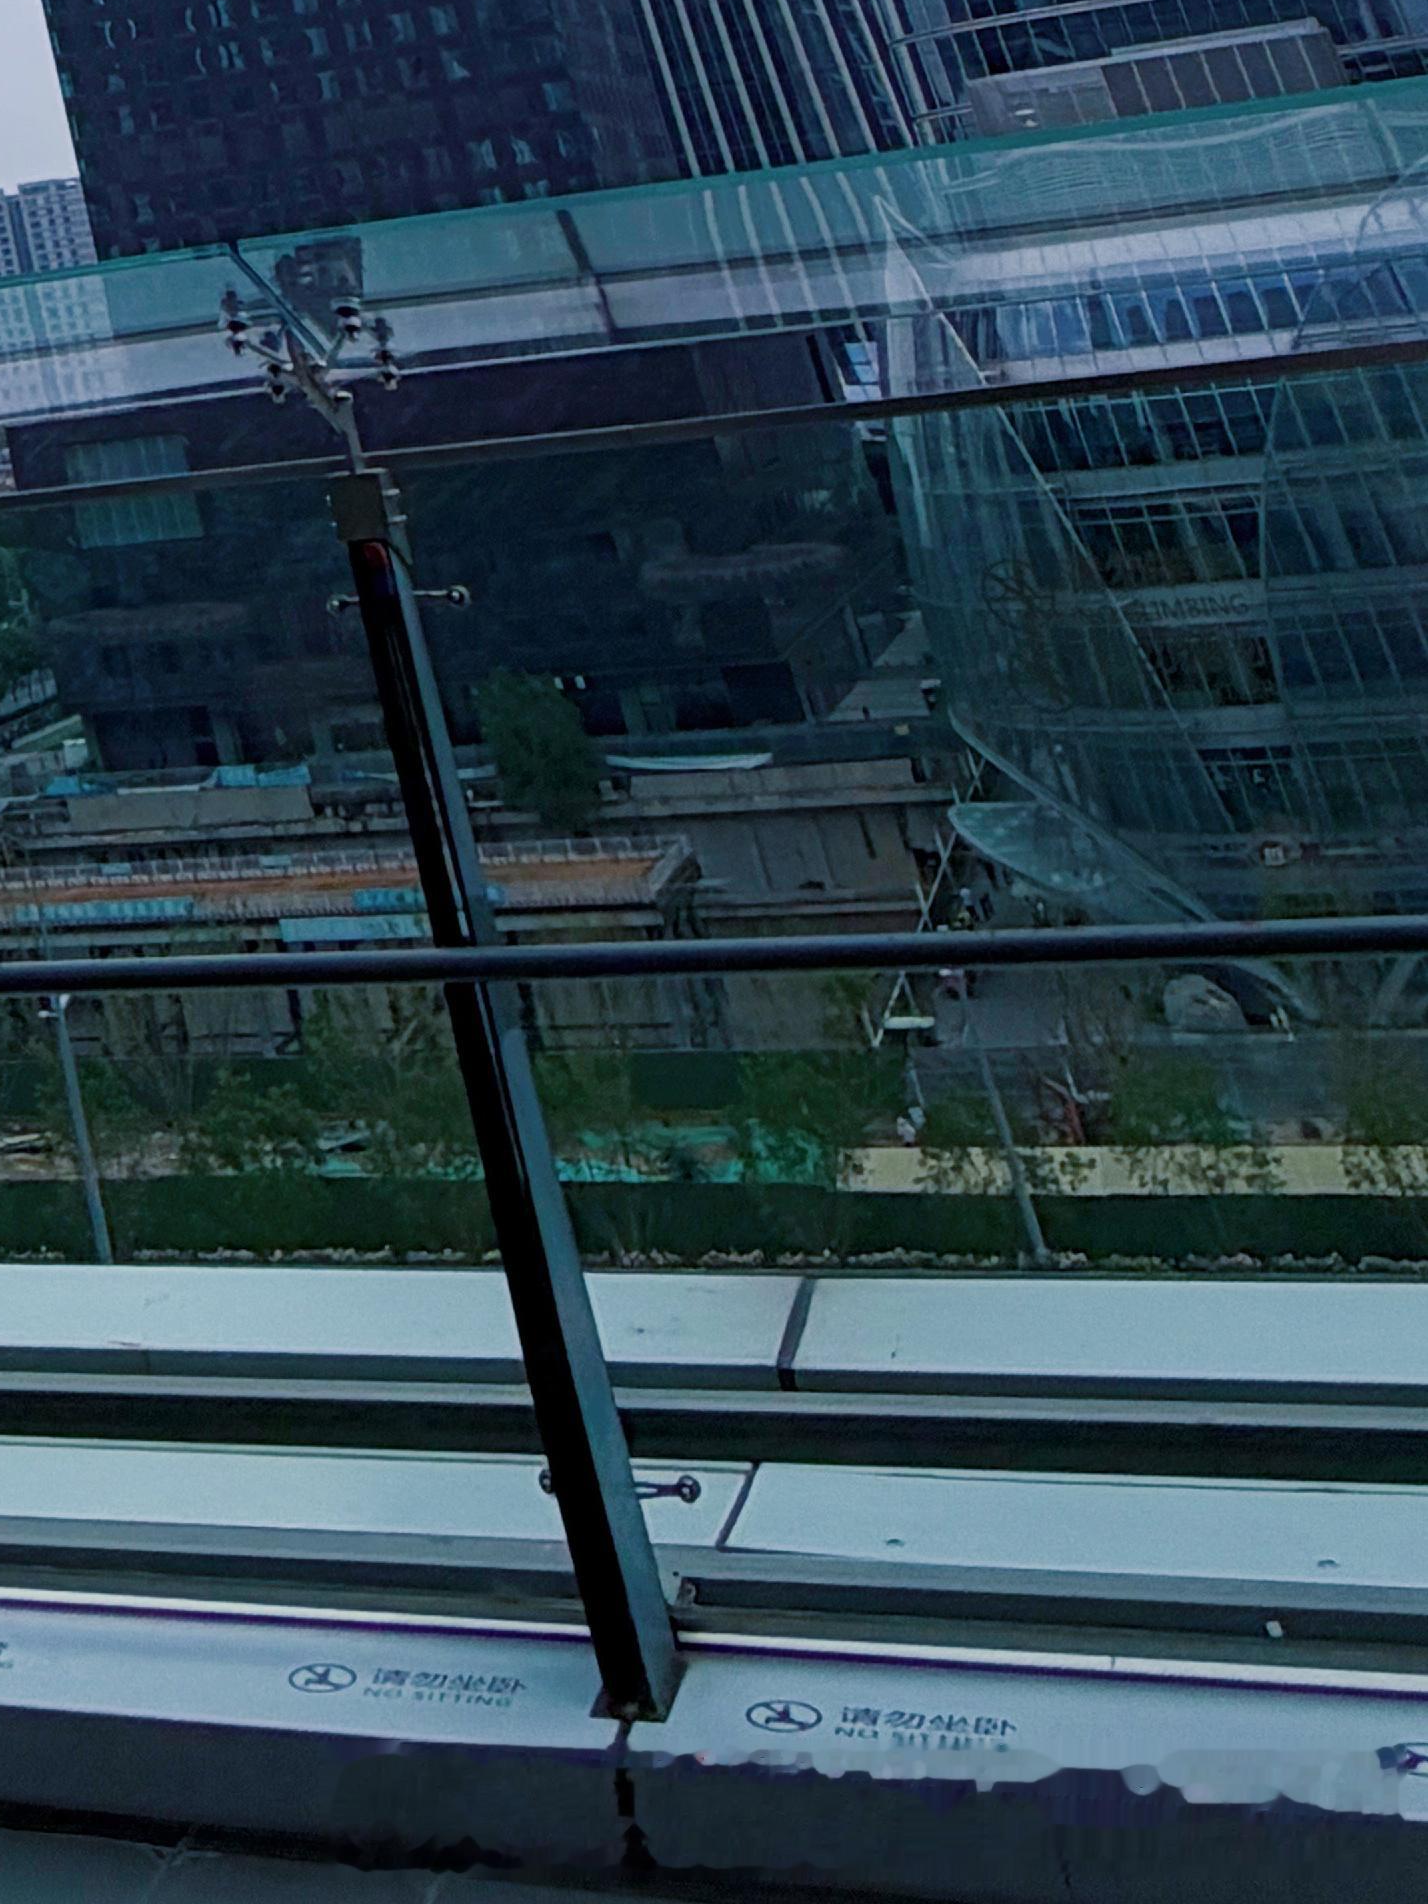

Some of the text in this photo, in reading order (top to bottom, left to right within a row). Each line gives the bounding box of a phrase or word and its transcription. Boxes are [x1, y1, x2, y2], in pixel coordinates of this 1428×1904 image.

[373, 1667, 527, 1694] 请勿坐卧
[364, 1687, 513, 1707] NO SITTING
[834, 1726, 879, 1739] NO
[841, 1706, 1017, 1737] 请勿坐卧
